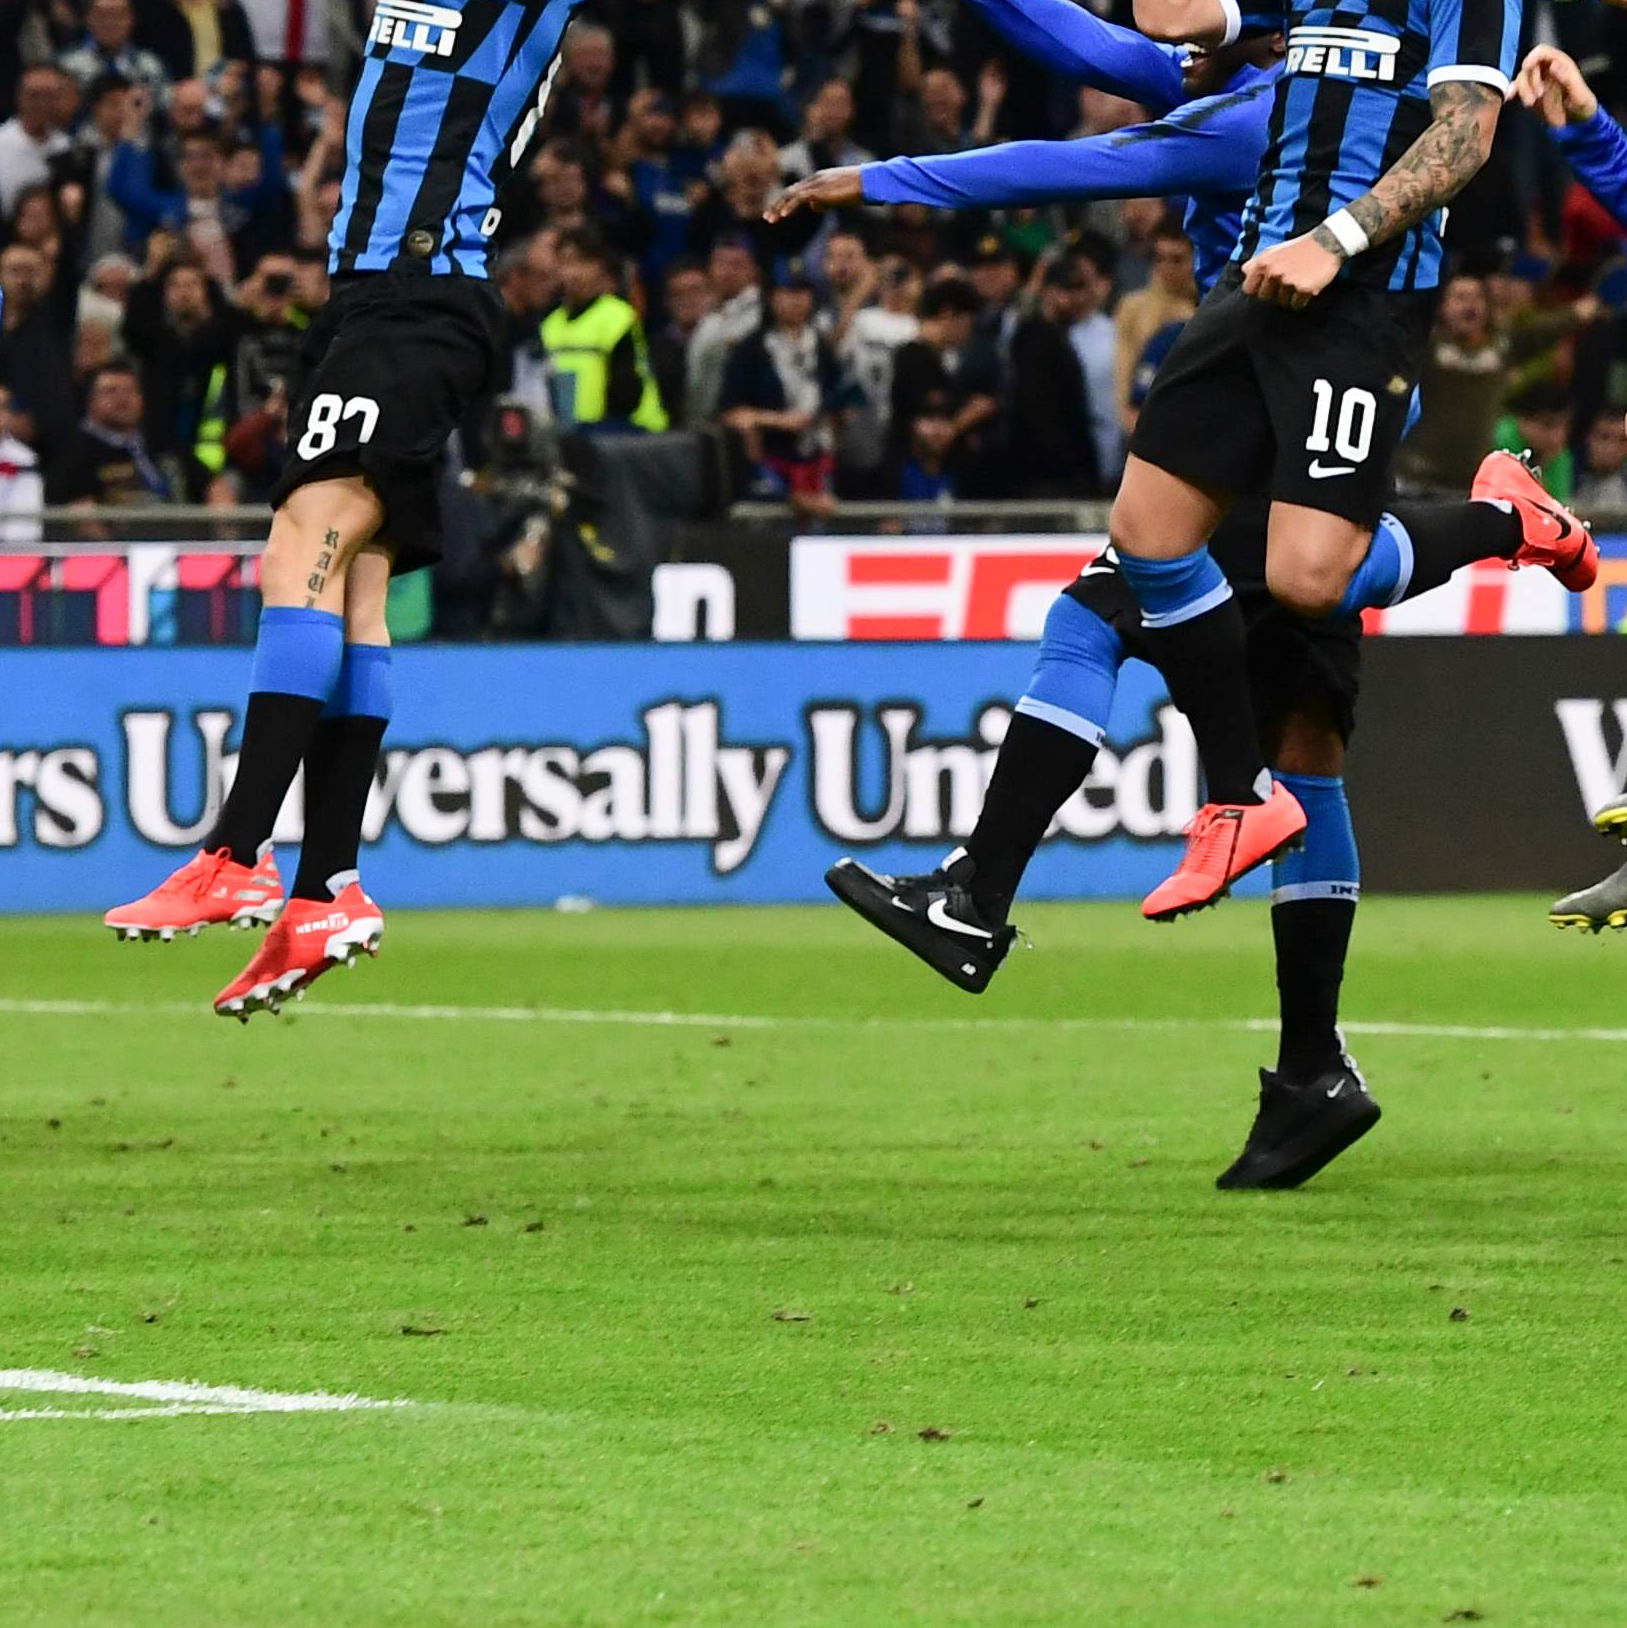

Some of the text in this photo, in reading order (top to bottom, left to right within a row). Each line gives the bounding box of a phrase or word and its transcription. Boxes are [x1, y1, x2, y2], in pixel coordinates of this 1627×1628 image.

[1284, 26, 1401, 81] PRELLI
[297, 393, 380, 461] 87
[1306, 379, 1377, 464] 10
[810, 703, 1198, 842] Unied
